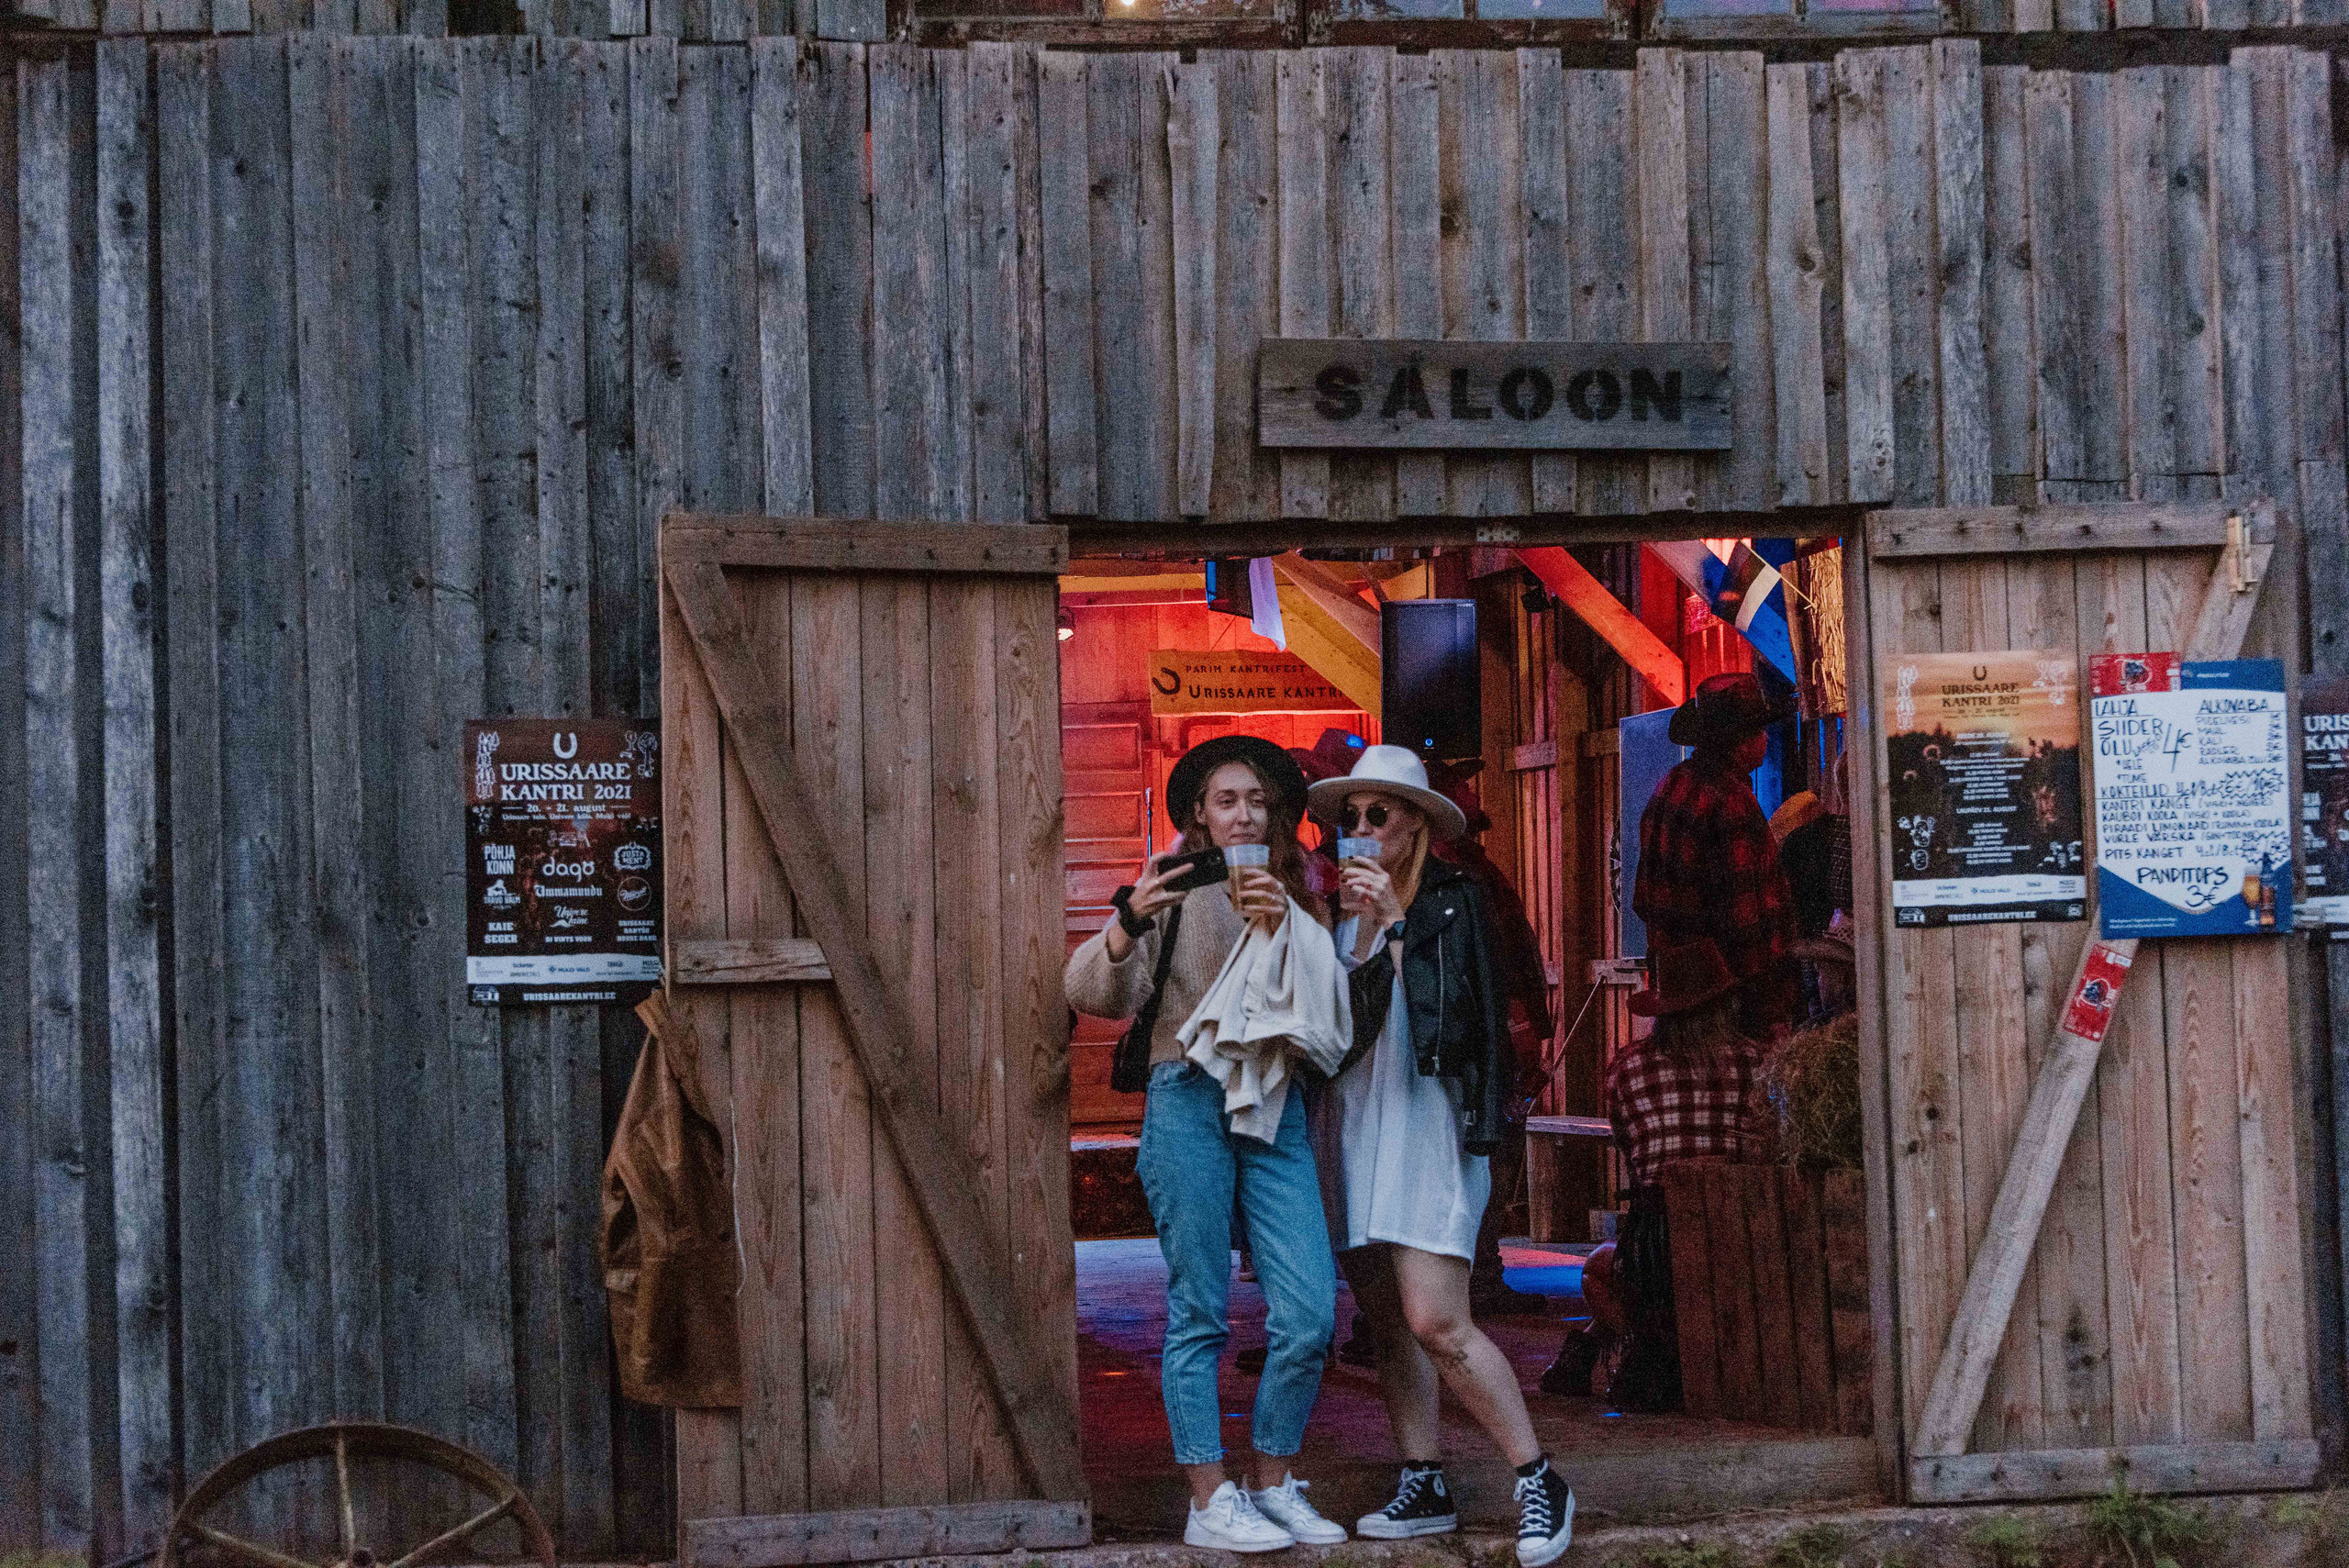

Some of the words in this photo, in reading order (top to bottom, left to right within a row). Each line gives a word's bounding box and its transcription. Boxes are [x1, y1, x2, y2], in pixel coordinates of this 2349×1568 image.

[1314, 366, 1683, 422] SALOON
[1186, 665, 1221, 673] PARIM
[1230, 664, 1306, 673] KANTRIFEST
[1942, 683, 2019, 695] URISSAARE
[1942, 696, 1991, 707] KANTRI
[1998, 695, 2019, 706] 2021
[2098, 718, 2165, 737] SIIDER
[2099, 737, 2132, 756] ÕLU
[500, 762, 632, 781] URISSAARE
[500, 783, 584, 801] KANTRI
[594, 784, 632, 800] 2021
[527, 804, 541, 813] 20.
[556, 803, 569, 813] 21.
[573, 803, 607, 814] august
[2102, 800, 2144, 811] KANTRI
[2151, 796, 2191, 809] KANGE
[2102, 811, 2142, 822] KAUBOI
[2147, 811, 2177, 820] KOOLA
[2102, 823, 2148, 833] PIRAADI
[2103, 833, 2139, 843] VURLE
[484, 843, 516, 860] PÕHJA
[2105, 849, 2132, 860] PITS
[2136, 846, 2183, 859] KANGET
[486, 860, 515, 874] KONN
[2136, 867, 2229, 885] PANDITOPS
[2185, 885, 2220, 907] 3€
[488, 922, 514, 931] KAIE
[484, 934, 518, 944] SEGER
